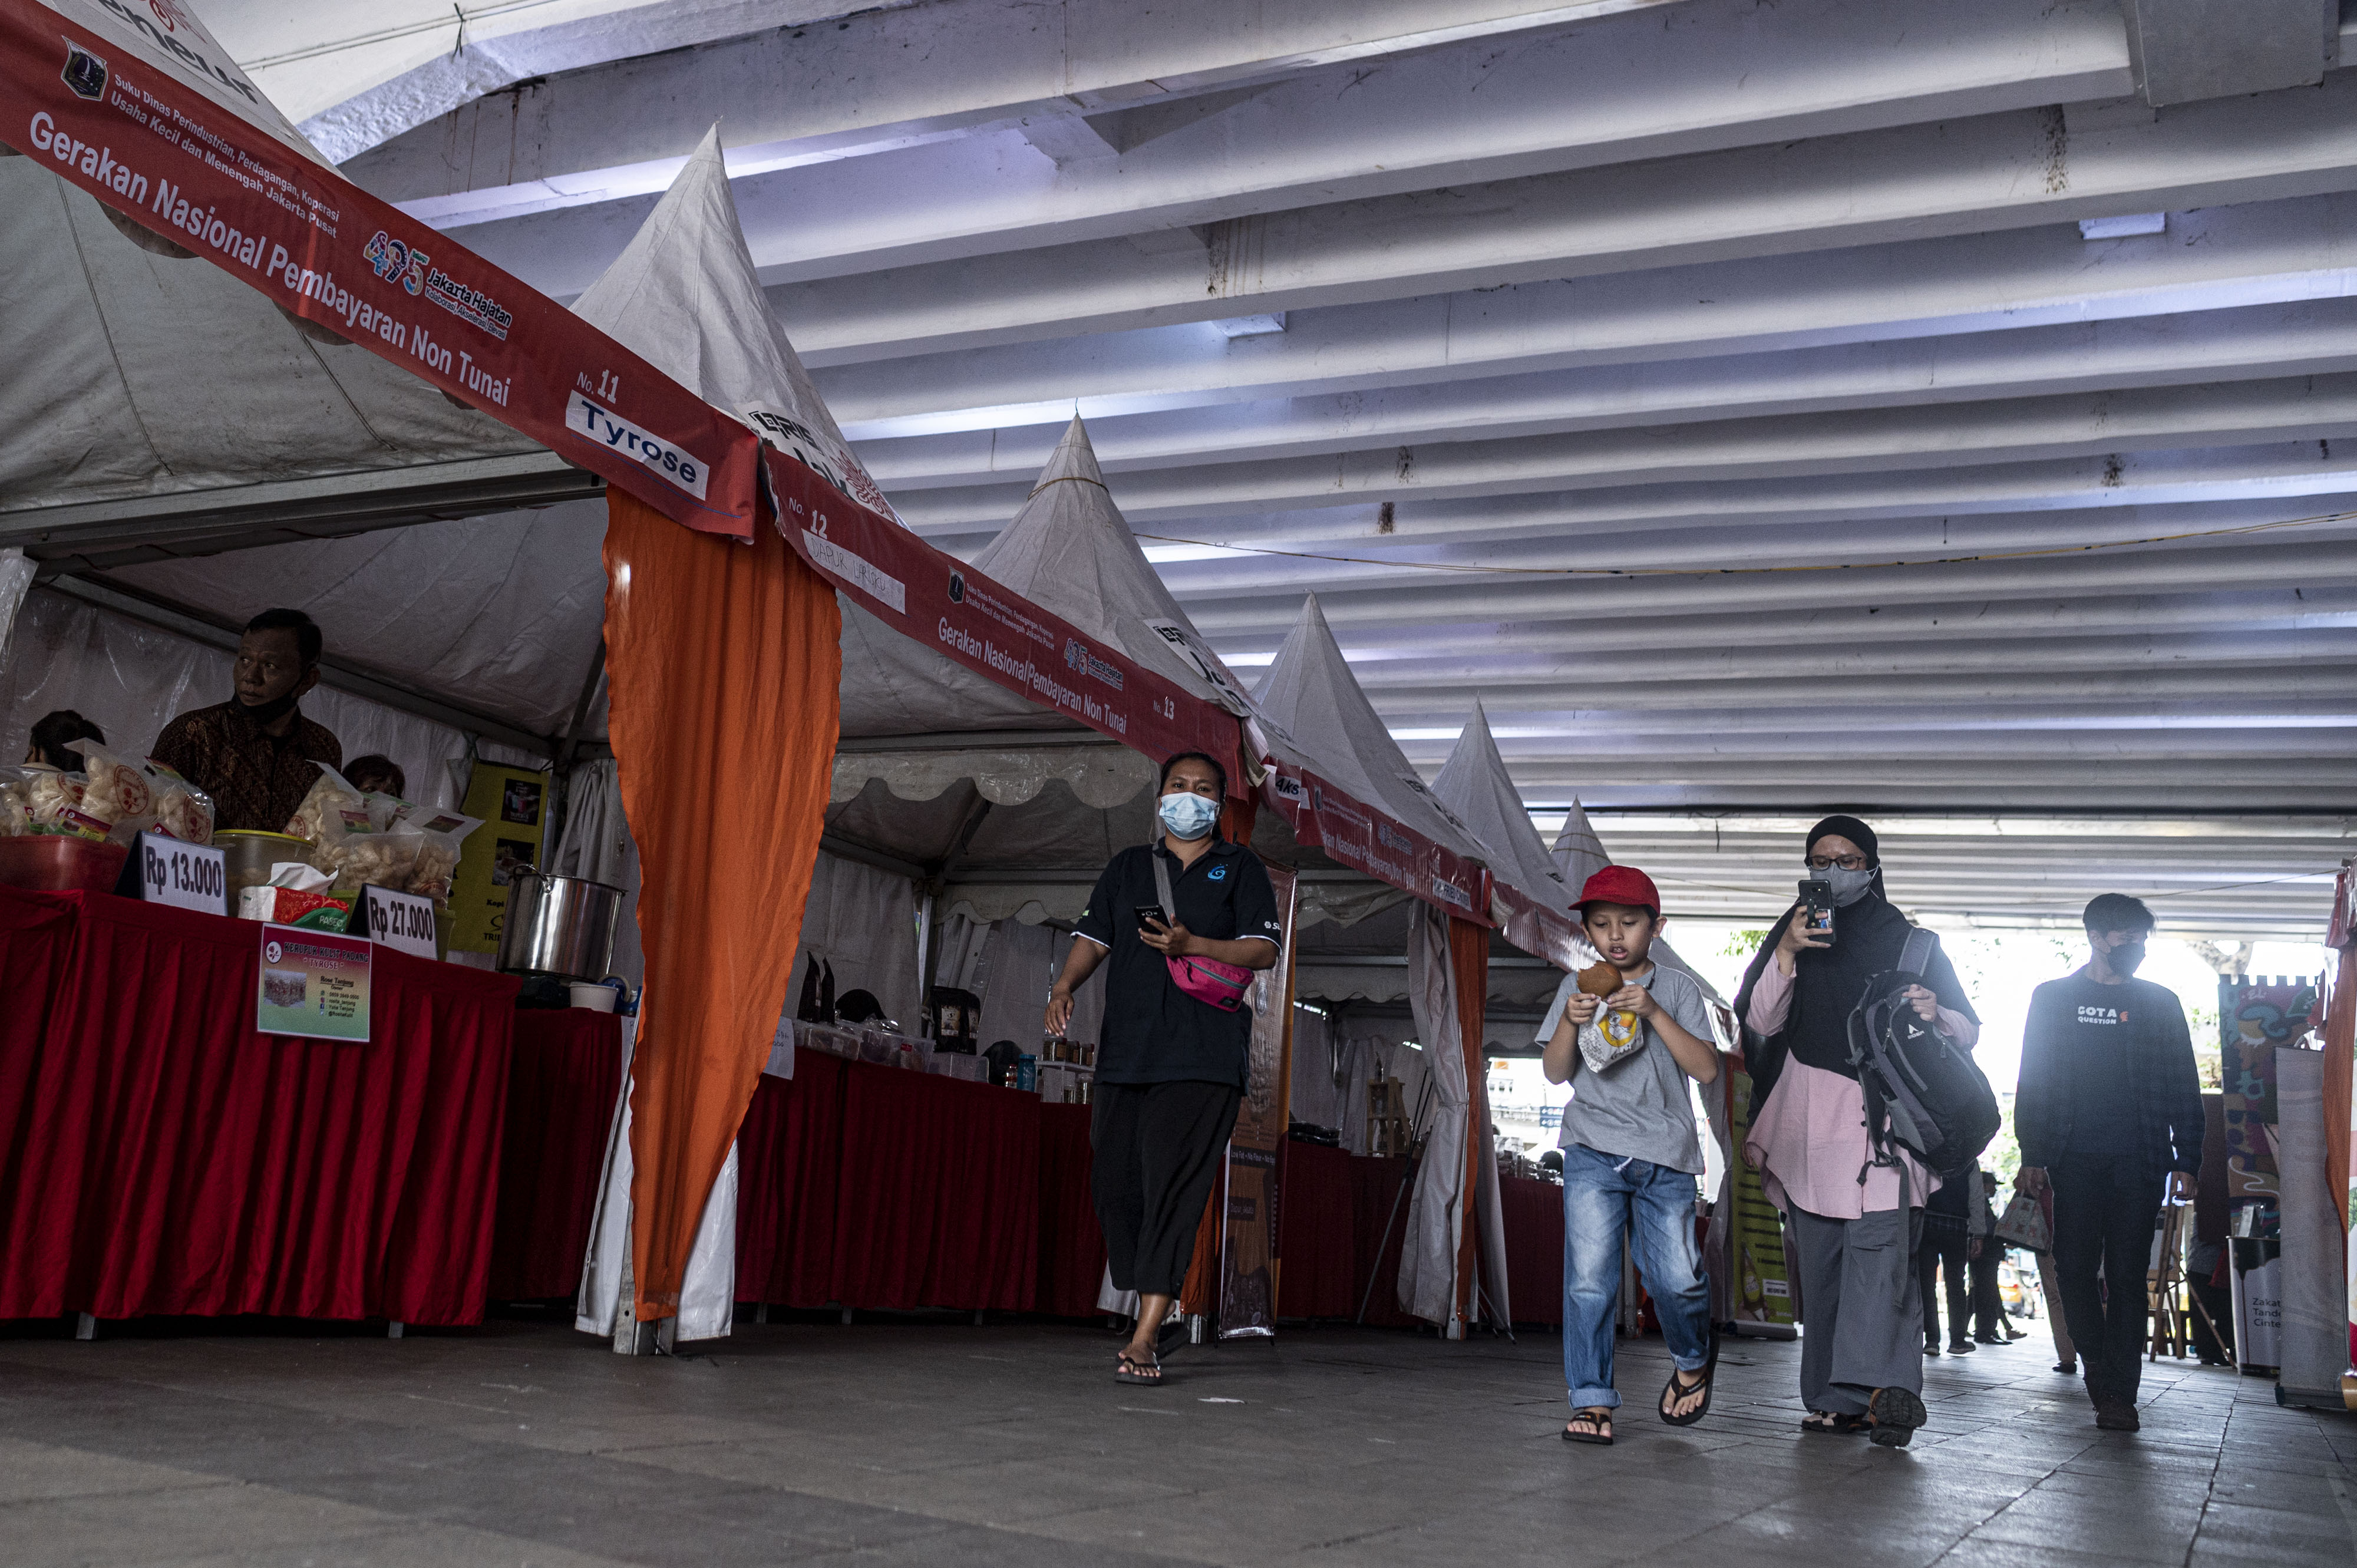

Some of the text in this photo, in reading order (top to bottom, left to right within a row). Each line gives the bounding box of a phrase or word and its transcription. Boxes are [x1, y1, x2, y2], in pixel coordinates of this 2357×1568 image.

[111, 90, 337, 239] Usaha Kecil dan Menengah Jakarta Pusat
[115, 74, 340, 222] Suku Dinas Perindustrian, Perdagangan, Koperasi
[30, 111, 511, 407] Gerakan Nasional Pembayaran Non Tunai
[425, 287, 457, 314] Kolaborasi,
[488, 322, 507, 339] Elevasi
[427, 269, 512, 327] Jakarta Hajatan
[576, 369, 619, 404] No. 11
[582, 400, 696, 483] Tyrose
[789, 497, 828, 539] No. 12
[811, 537, 848, 570] DAPUR
[967, 583, 977, 595] Suku
[977, 589, 988, 602] Dinas
[966, 594, 1055, 651] Usaha Kecil dan Menengah Jakarta Pusat
[938, 617, 982, 660] Gerakan
[983, 640, 1028, 683] Nasional
[1028, 663, 1082, 712] Pembayaran
[1084, 694, 1102, 722] Non
[1104, 704, 1127, 735] Tunai
[1088, 654, 1106, 672] Jakarta
[1153, 698, 1174, 720] No. 13
[146, 846, 222, 897] Rp 13.000
[1336, 833, 1362, 860] Nasional
[1362, 845, 1391, 874] Pebayaran
[319, 916, 343, 927] PASEO
[370, 897, 433, 941] Rp 27.000
[284, 942, 369, 963] KERUPUK KULIT PADANG
[309, 959, 339, 969] TYROSE
[335, 978, 354, 987] Tanjung
[2078, 1006, 2117, 1018] GOT A
[2078, 1016, 2117, 1025] QUESTION
[2253, 1298, 2281, 1307] Zakat
